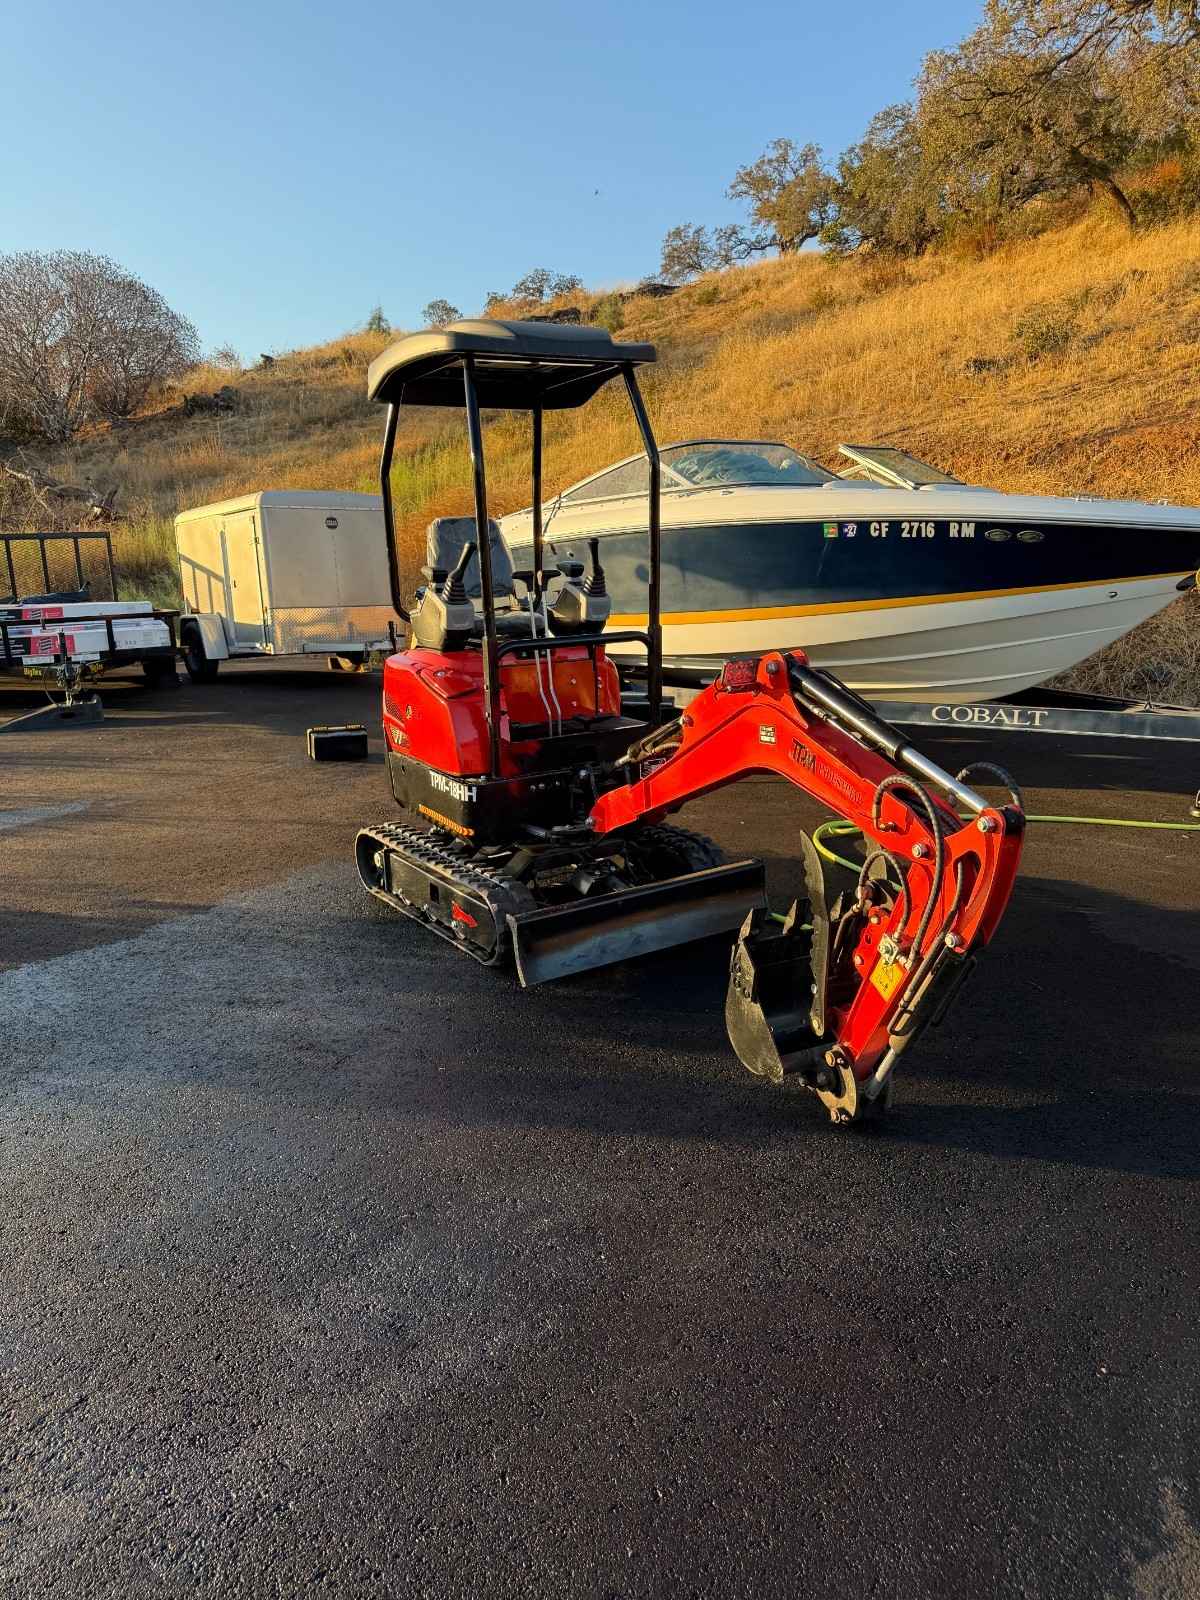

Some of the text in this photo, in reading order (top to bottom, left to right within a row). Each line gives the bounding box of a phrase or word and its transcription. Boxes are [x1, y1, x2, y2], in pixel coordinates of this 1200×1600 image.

[847, 524, 858, 535] 27
[869, 521, 975, 538] CF 2716 RM
[23, 667, 42, 677] BigTex
[931, 705, 1049, 726] COBALT
